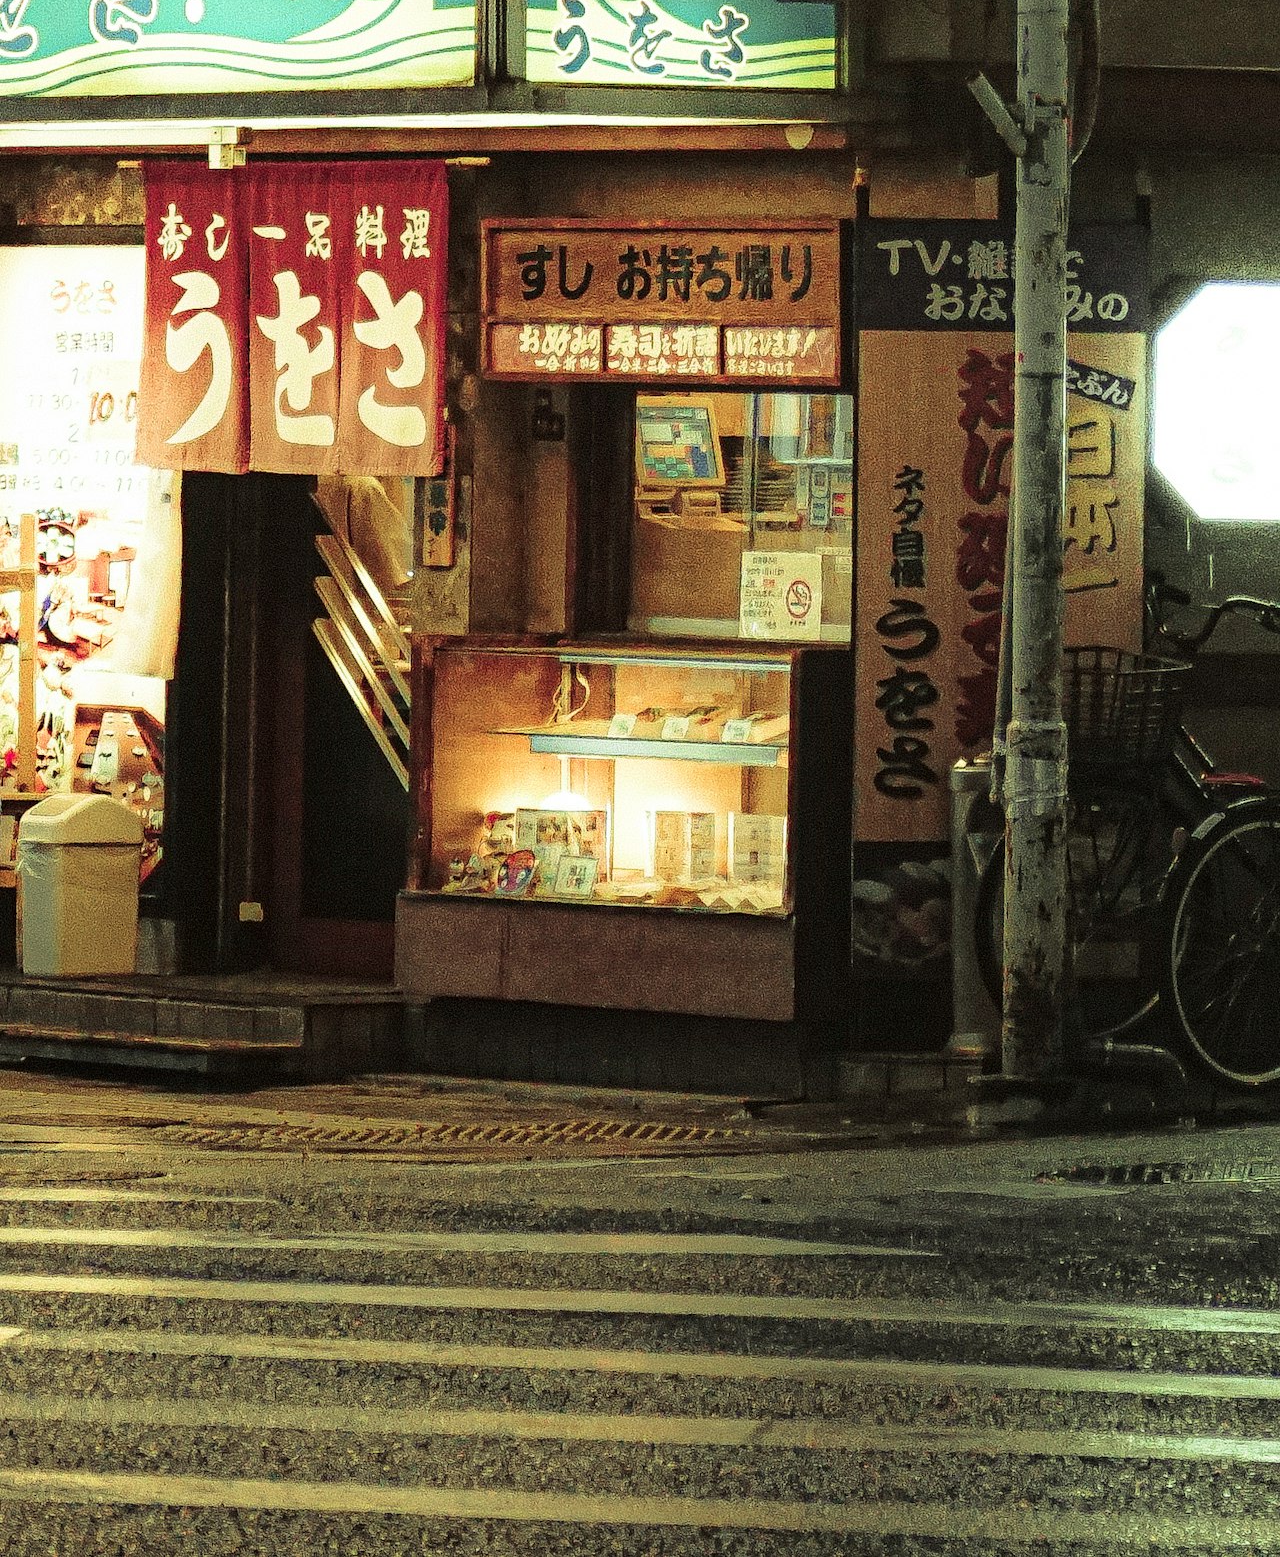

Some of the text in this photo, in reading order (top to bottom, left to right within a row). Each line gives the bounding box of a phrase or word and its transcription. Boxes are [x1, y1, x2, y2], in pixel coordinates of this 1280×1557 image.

[516, 243, 813, 302] すし お持ち帰り
[923, 284, 1130, 323] おなみの
[165, 270, 427, 448] うをさ
[874, 600, 941, 799] うをさ
